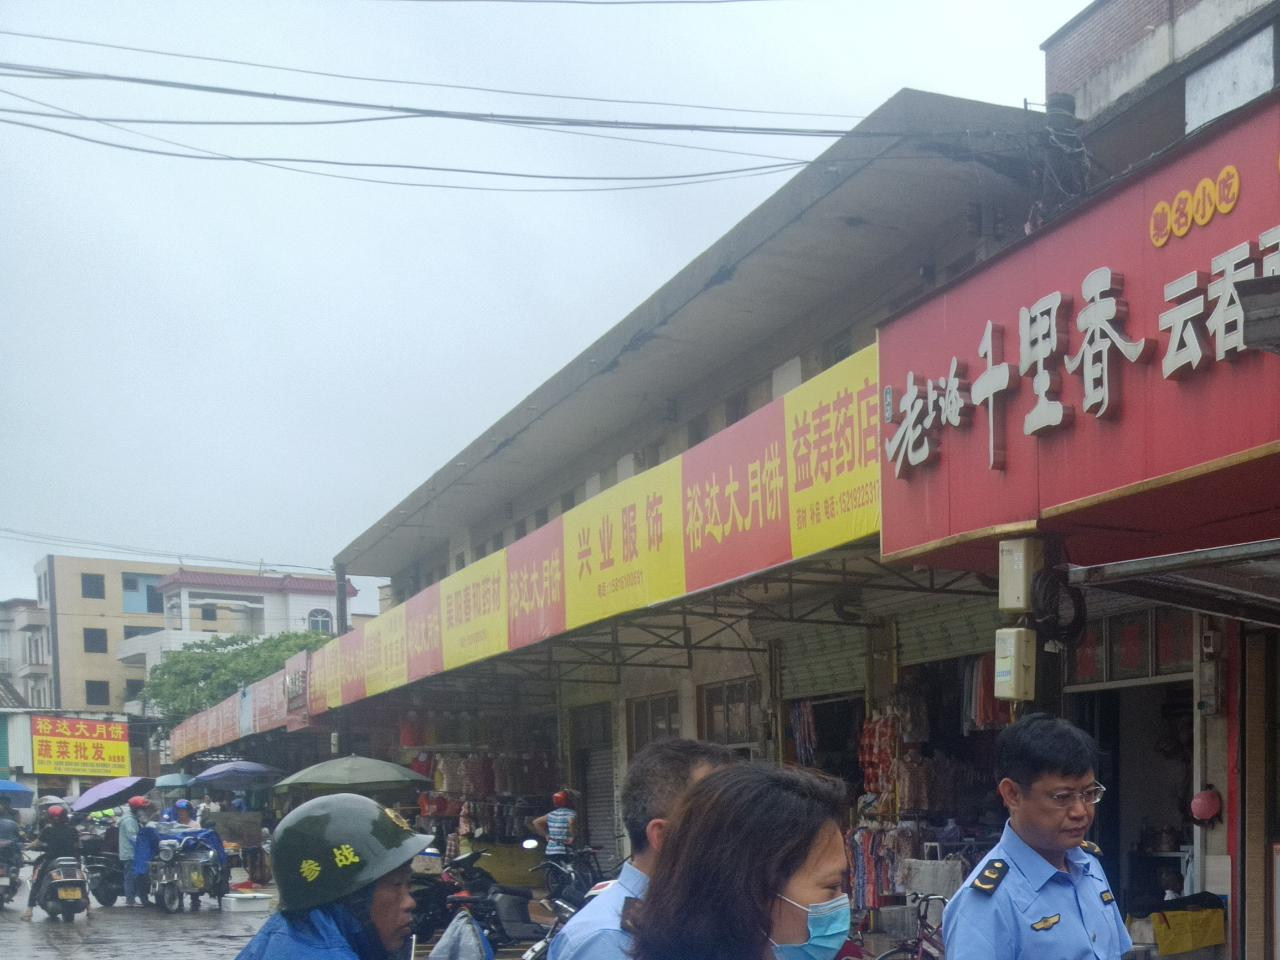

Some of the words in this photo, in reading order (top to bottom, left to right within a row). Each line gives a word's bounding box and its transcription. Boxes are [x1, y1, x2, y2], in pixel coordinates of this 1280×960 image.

[792, 377, 879, 493] 益寿药店
[577, 492, 664, 581] 兴业服饰
[686, 441, 784, 553] 裕达大月饼
[36, 718, 124, 739] 裕达大月饼
[299, 844, 361, 882] 参战
